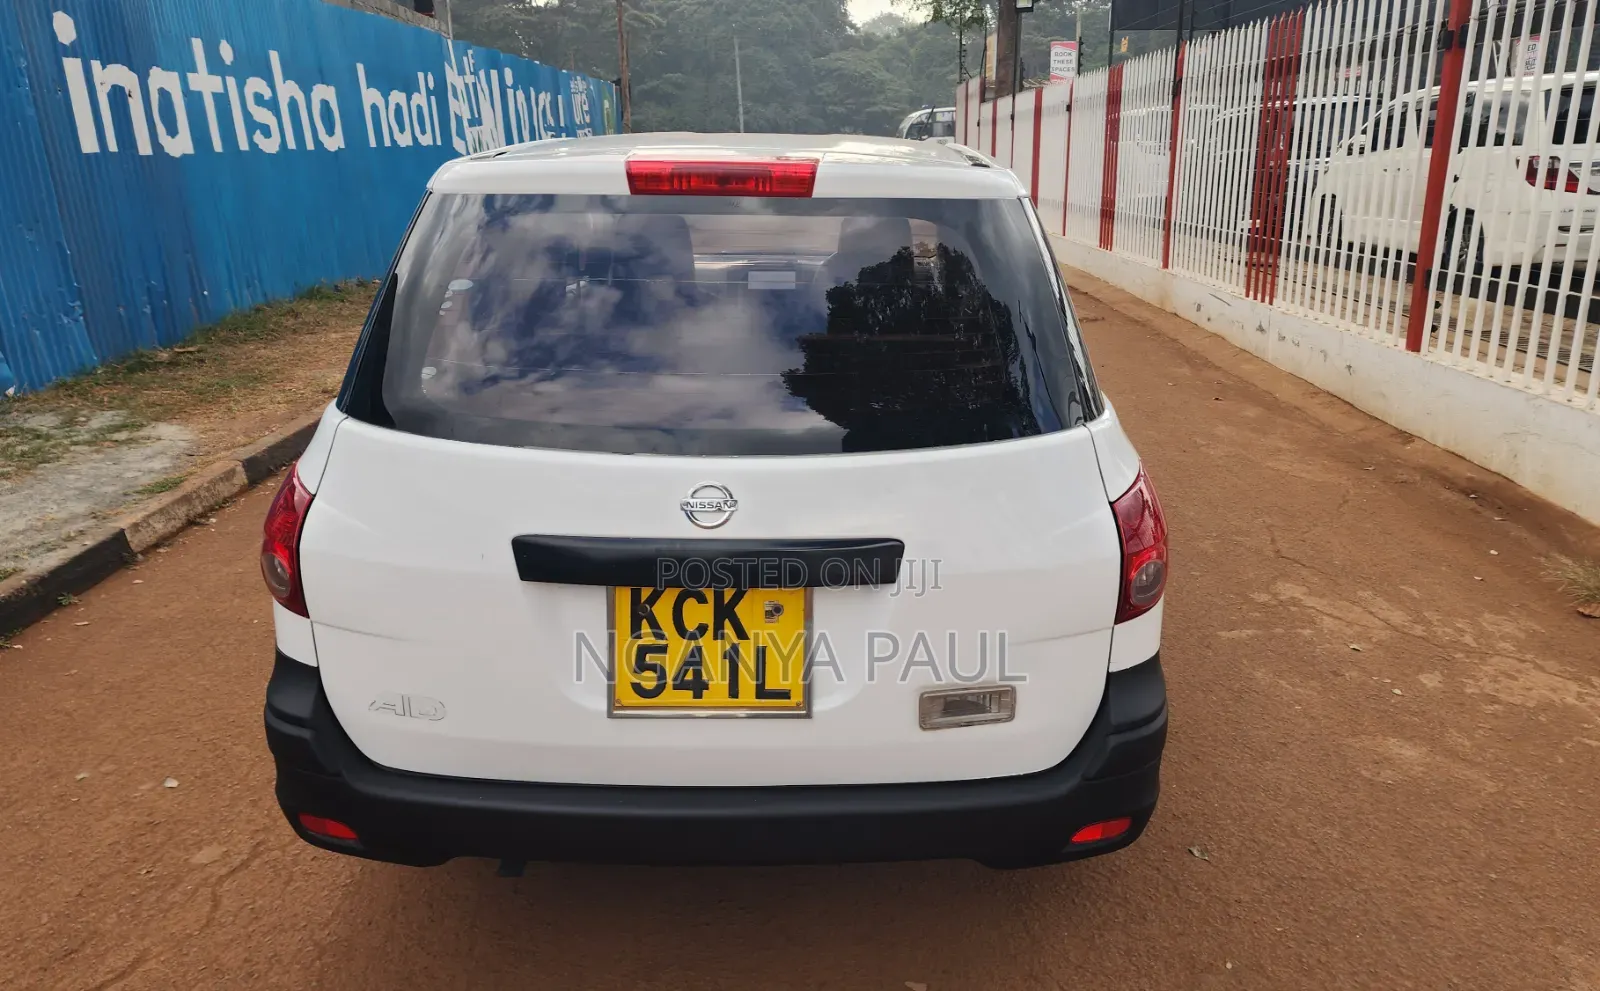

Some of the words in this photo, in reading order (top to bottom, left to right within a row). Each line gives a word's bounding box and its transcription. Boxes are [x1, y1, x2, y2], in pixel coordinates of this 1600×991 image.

[53, 11, 345, 158] inatisha
[356, 62, 442, 148] hadi
[685, 501, 733, 509] NISSAN
[630, 587, 751, 641] KCK
[630, 643, 792, 700] 541L
[367, 693, 447, 722] AD
